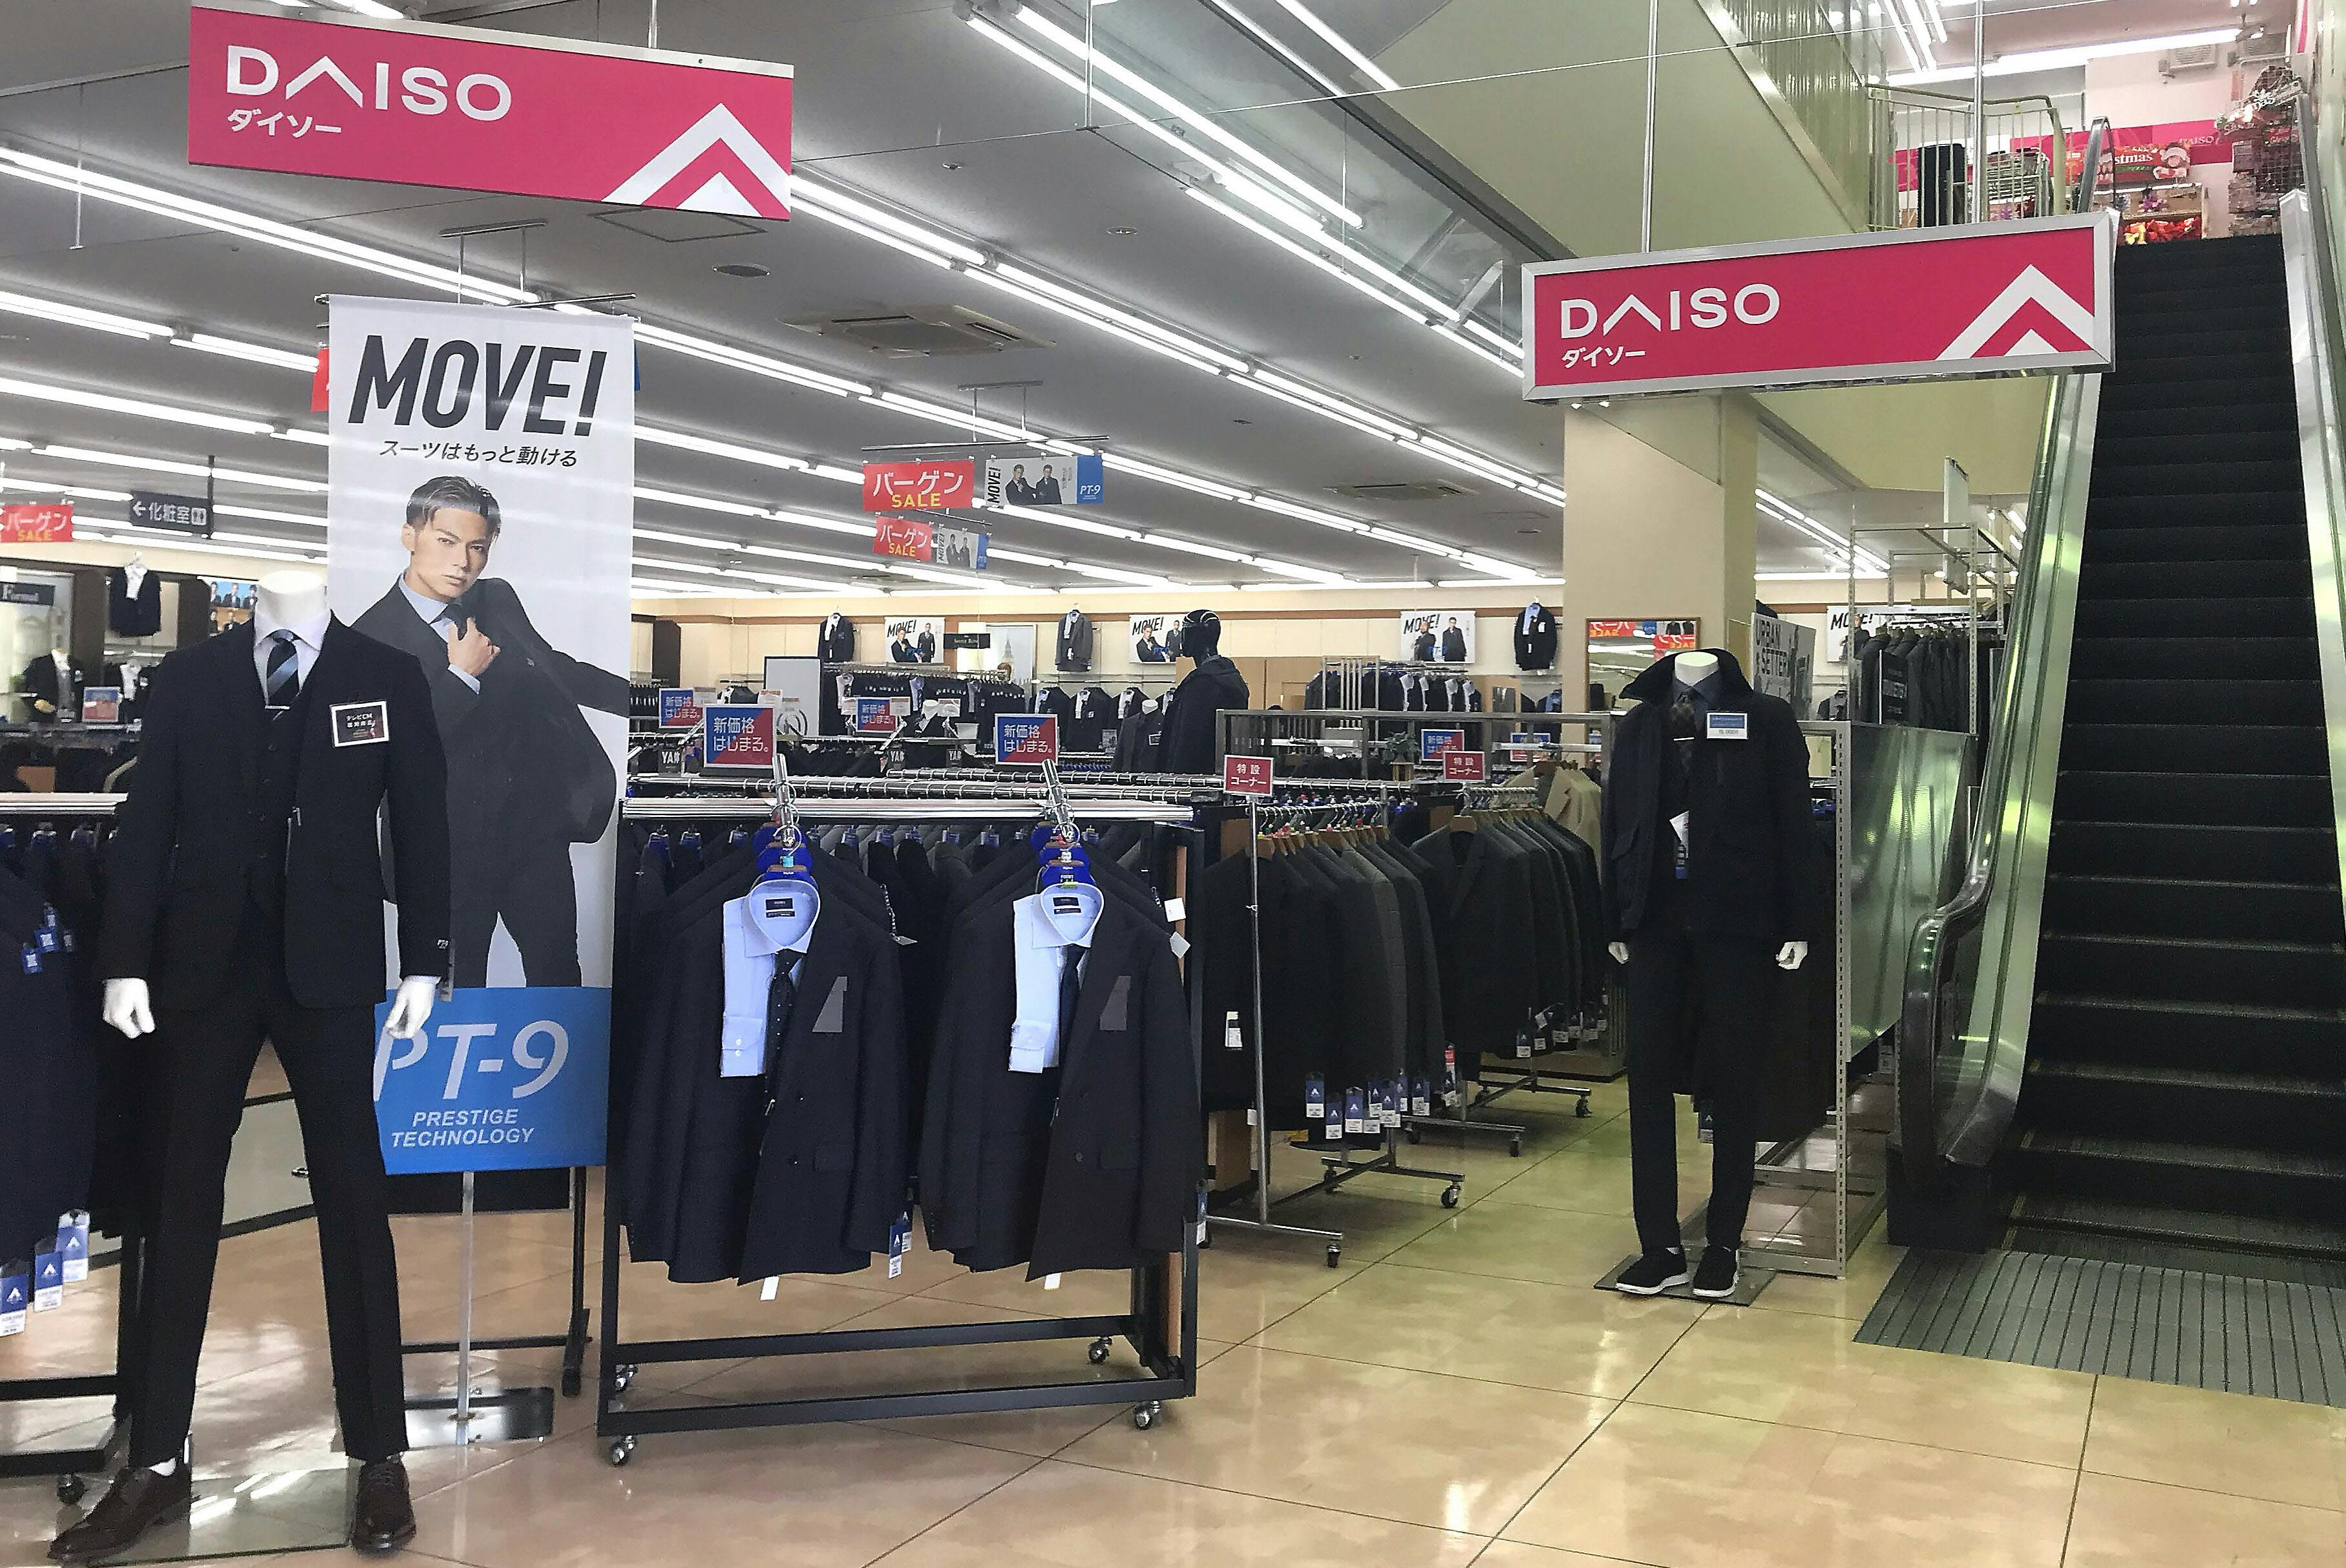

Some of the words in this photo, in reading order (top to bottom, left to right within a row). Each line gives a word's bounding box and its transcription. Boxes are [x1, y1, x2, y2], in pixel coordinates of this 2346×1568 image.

[227, 45, 512, 122] DAISO
[227, 109, 342, 138] ダイソー
[1561, 283, 1780, 340] DAISO
[1561, 346, 1646, 368] ダイソー
[348, 335, 608, 437] MOVE!
[379, 440, 578, 467] スーツはもっと動ける
[873, 470, 964, 496] バーゲン
[987, 467, 1001, 503] MOVE!
[1080, 484, 1101, 495] PT-9
[891, 493, 942, 507] SALE
[5, 512, 67, 531] バーゲン
[149, 502, 190, 524] 化粧室
[17, 530, 52, 542] SALE
[880, 525, 927, 548] バーゲン
[889, 543, 916, 556] SALE
[713, 717, 755, 734] 新価格
[1004, 725, 1041, 738] 新価格
[713, 736, 769, 752] はじまる。
[1004, 739, 1052, 753] はじまる。
[1236, 763, 1260, 774] 特設
[1231, 776, 1267, 787] コーナー
[373, 1020, 569, 1102] PT-9
[412, 1108, 519, 1128] PRESTIGE
[391, 1127, 535, 1148] TECHNOLOGY
